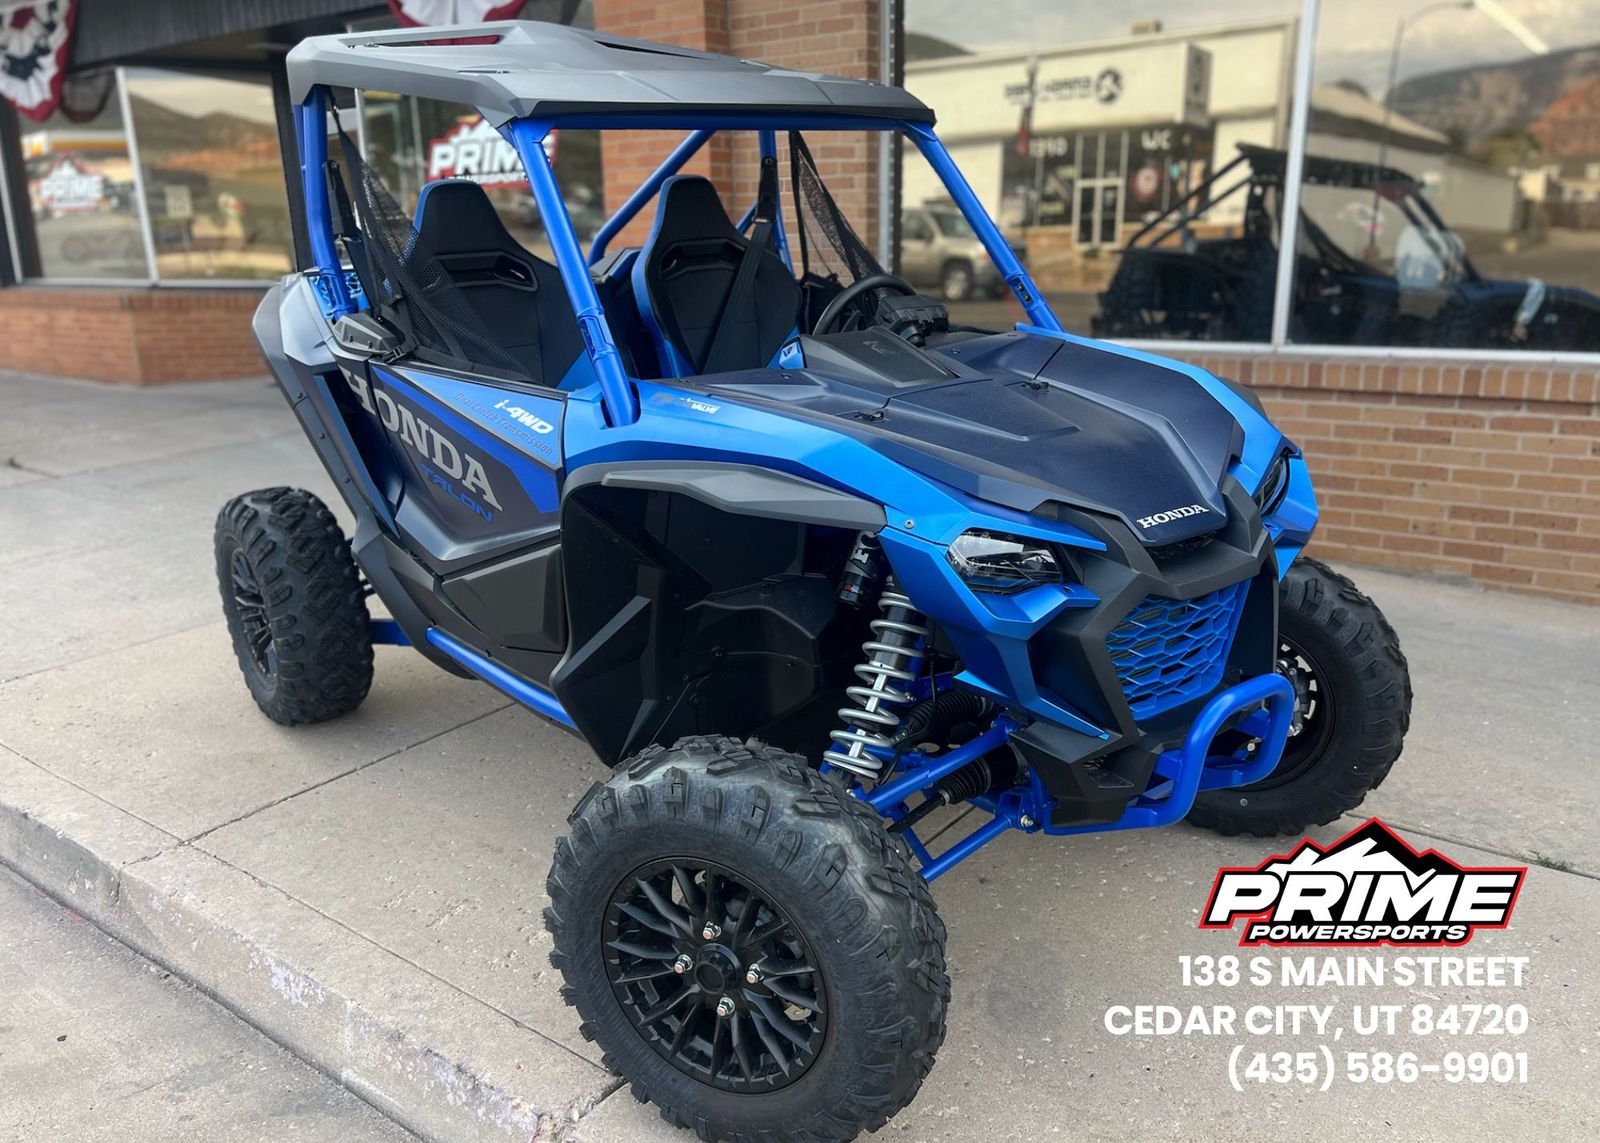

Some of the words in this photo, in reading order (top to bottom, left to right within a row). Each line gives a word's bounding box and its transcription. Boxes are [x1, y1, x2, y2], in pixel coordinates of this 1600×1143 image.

[494, 399, 554, 434] i-4WD
[498, 416, 554, 455] Transmission
[338, 363, 503, 512] HONDA
[420, 462, 495, 524] TALON
[1136, 504, 1209, 529] HONDA
